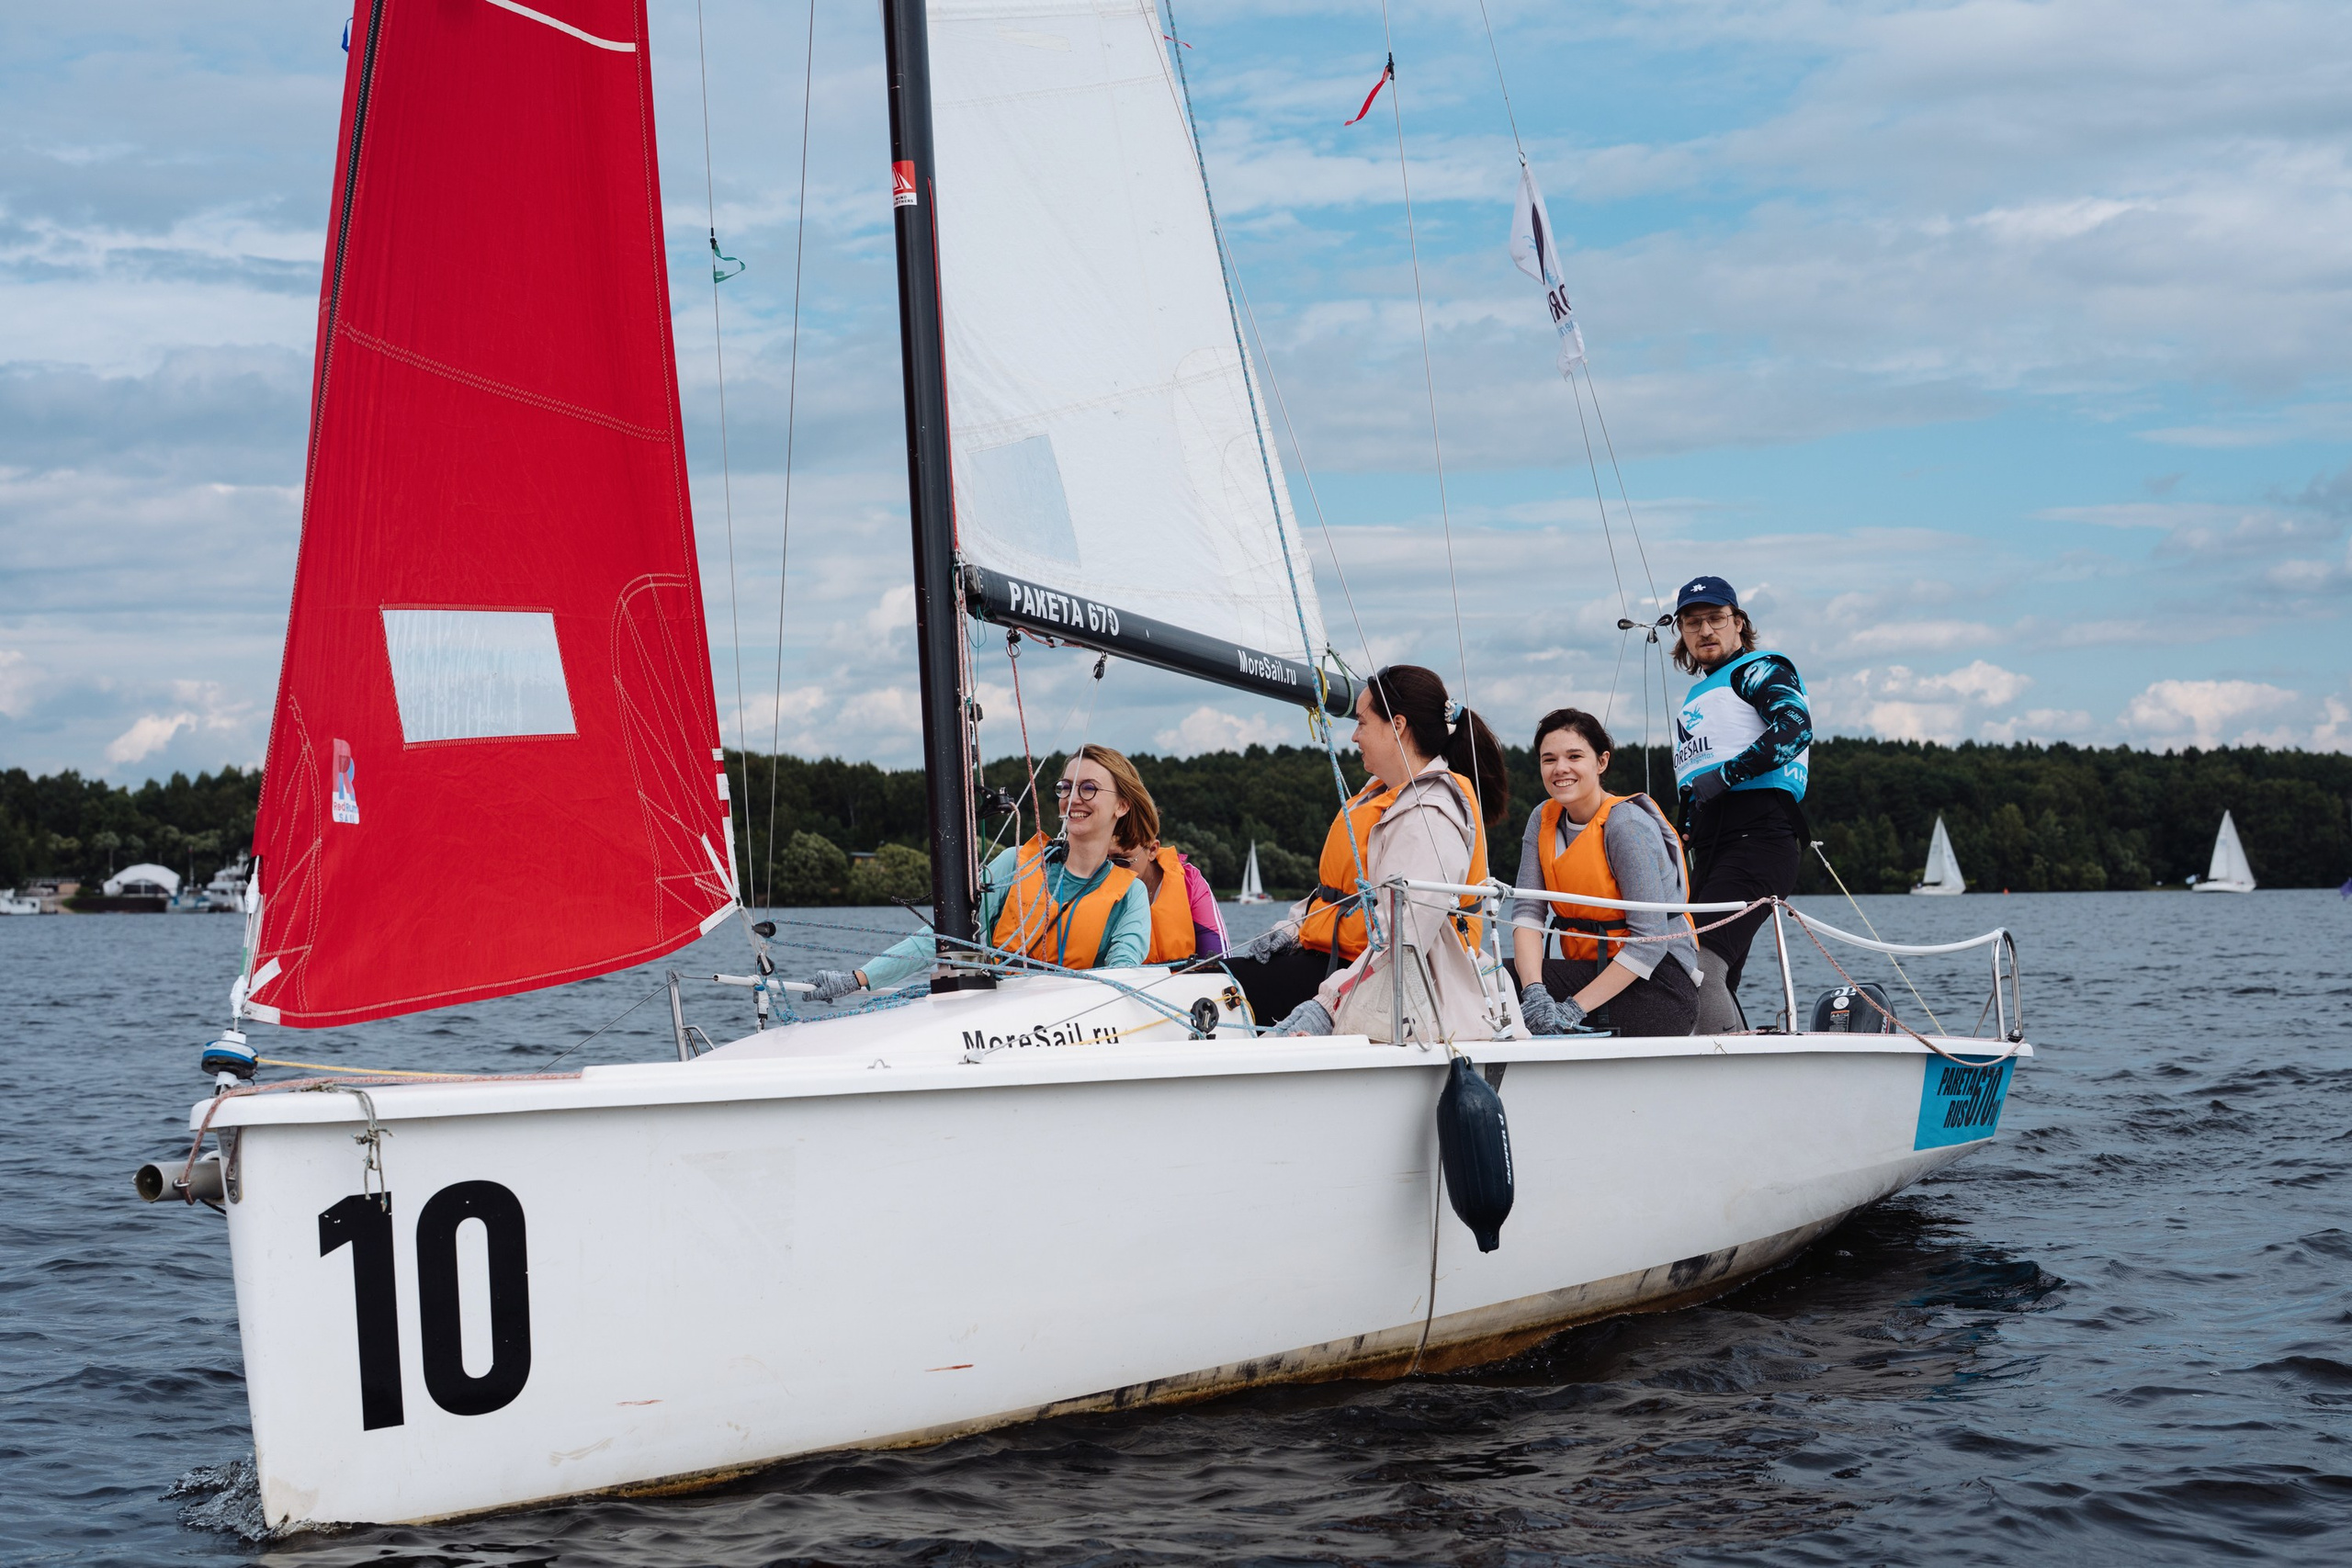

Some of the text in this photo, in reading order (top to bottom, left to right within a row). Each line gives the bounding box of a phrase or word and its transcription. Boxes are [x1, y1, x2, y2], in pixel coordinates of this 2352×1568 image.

[1088, 604, 1121, 637] 670
[1237, 649, 1297, 686] MoreSail.ru
[1674, 736, 1713, 769] ORESAIL
[962, 1022, 1120, 1049] MoreSailru
[1943, 1100, 1968, 1128] RUS
[318, 1179, 532, 1432] 10
